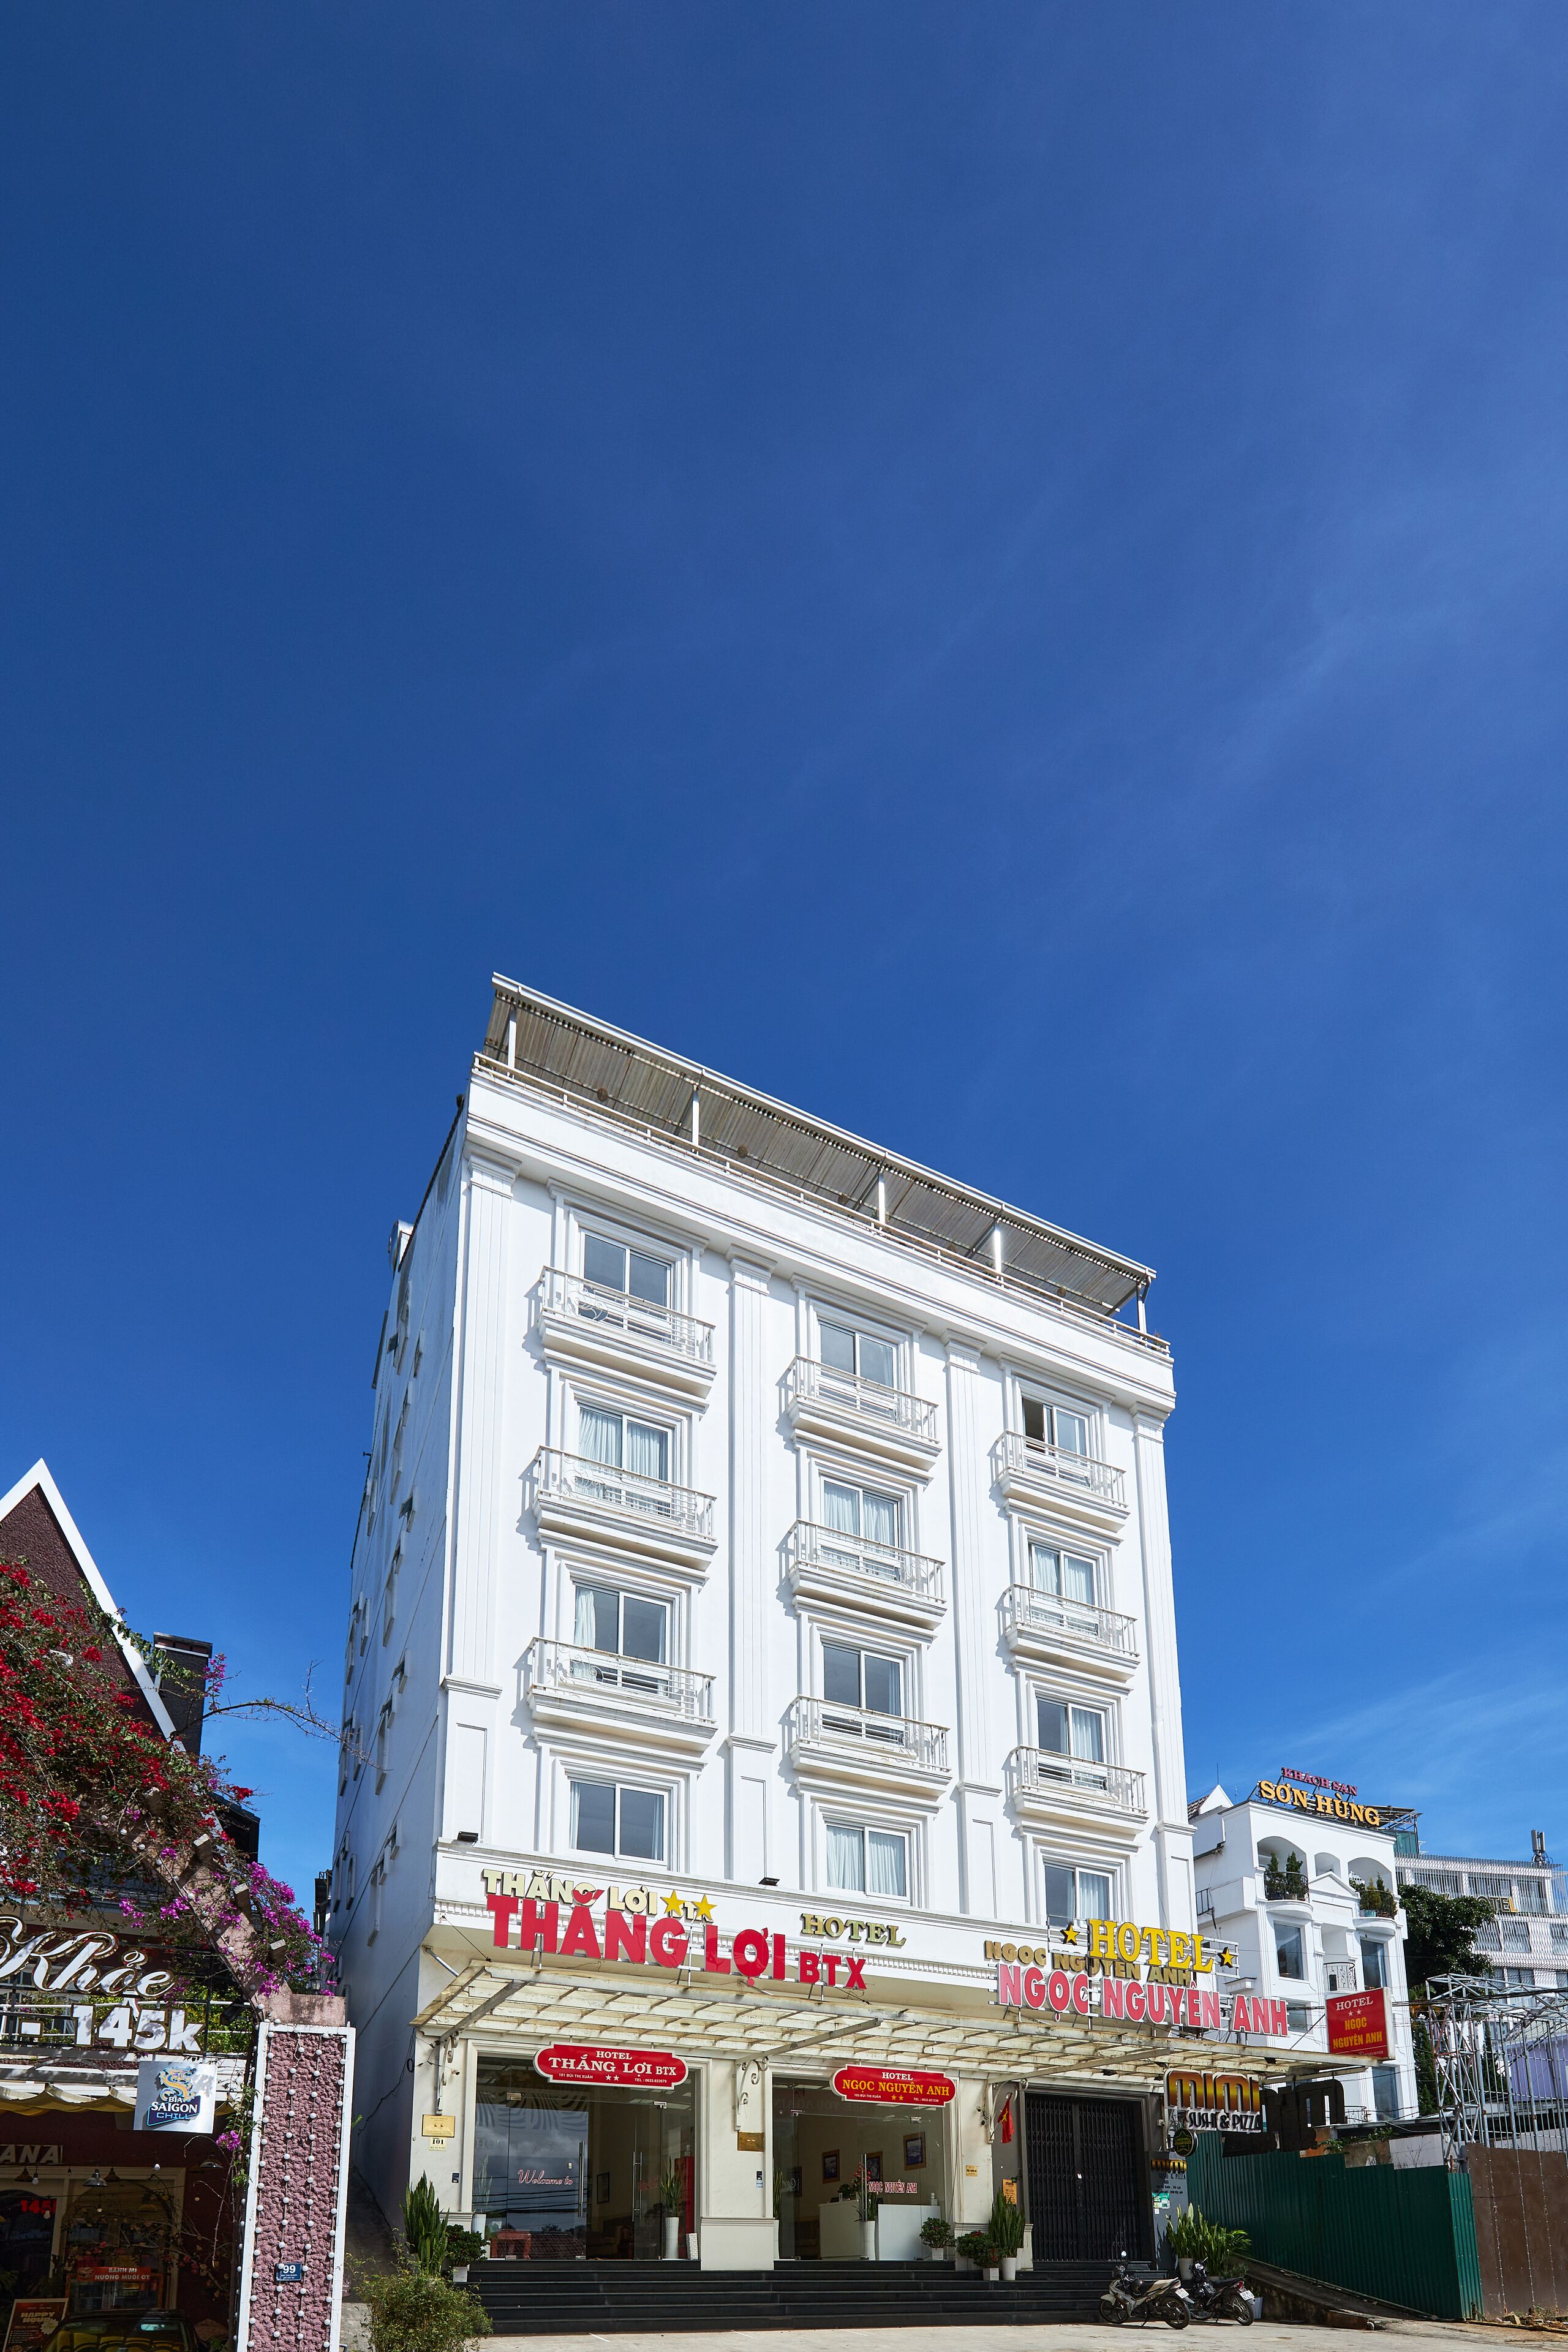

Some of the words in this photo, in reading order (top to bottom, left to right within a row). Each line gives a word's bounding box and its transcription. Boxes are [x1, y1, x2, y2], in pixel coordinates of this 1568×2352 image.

[1283, 1768, 1330, 1789] KHÁCH
[1259, 1780, 1308, 1807] SƠN
[1315, 1792, 1380, 1825] HÙNG
[801, 1913, 907, 1946] HOTEL
[487, 1889, 689, 1968] THẮNG
[704, 1924, 786, 1987] LỢI
[799, 1951, 867, 1990] BTX
[1087, 1918, 1213, 1973] HOTEL
[1147, 1966, 1191, 1986] ANH
[997, 1964, 1090, 2022] NGỌC
[1101, 1978, 1221, 2029] NGUYÊN
[1232, 1994, 1289, 2037] ANH
[1336, 1996, 1373, 2011] HOTEL
[72, 2004, 204, 2052] 145k
[1344, 2016, 1367, 2030] NGỌC
[1333, 2033, 1363, 2049] NGUYÊN
[1365, 2030, 1382, 2044] ANH
[596, 2051, 633, 2060] HOTEL
[548, 2054, 616, 2072] THẮNG
[622, 2062, 652, 2077] LỢI
[655, 2066, 677, 2076] BTX
[881, 2071, 913, 2081] HOTEL
[842, 2079, 875, 2093] NGỌC
[878, 2081, 924, 2094] NGUYÊN
[926, 2085, 949, 2096] ANH
[151, 2101, 198, 2114] SAIGON
[1188, 2112, 1217, 2128] SUSHI
[1219, 2113, 1231, 2128] &
[517, 2169, 563, 2185] Welcome
[564, 2176, 573, 2185] to
[868, 2181, 883, 2195] NGỌC
[884, 2179, 905, 2193] NGUYÊN
[907, 2182, 918, 2193] ANH
[283, 2264, 296, 2274] 99
